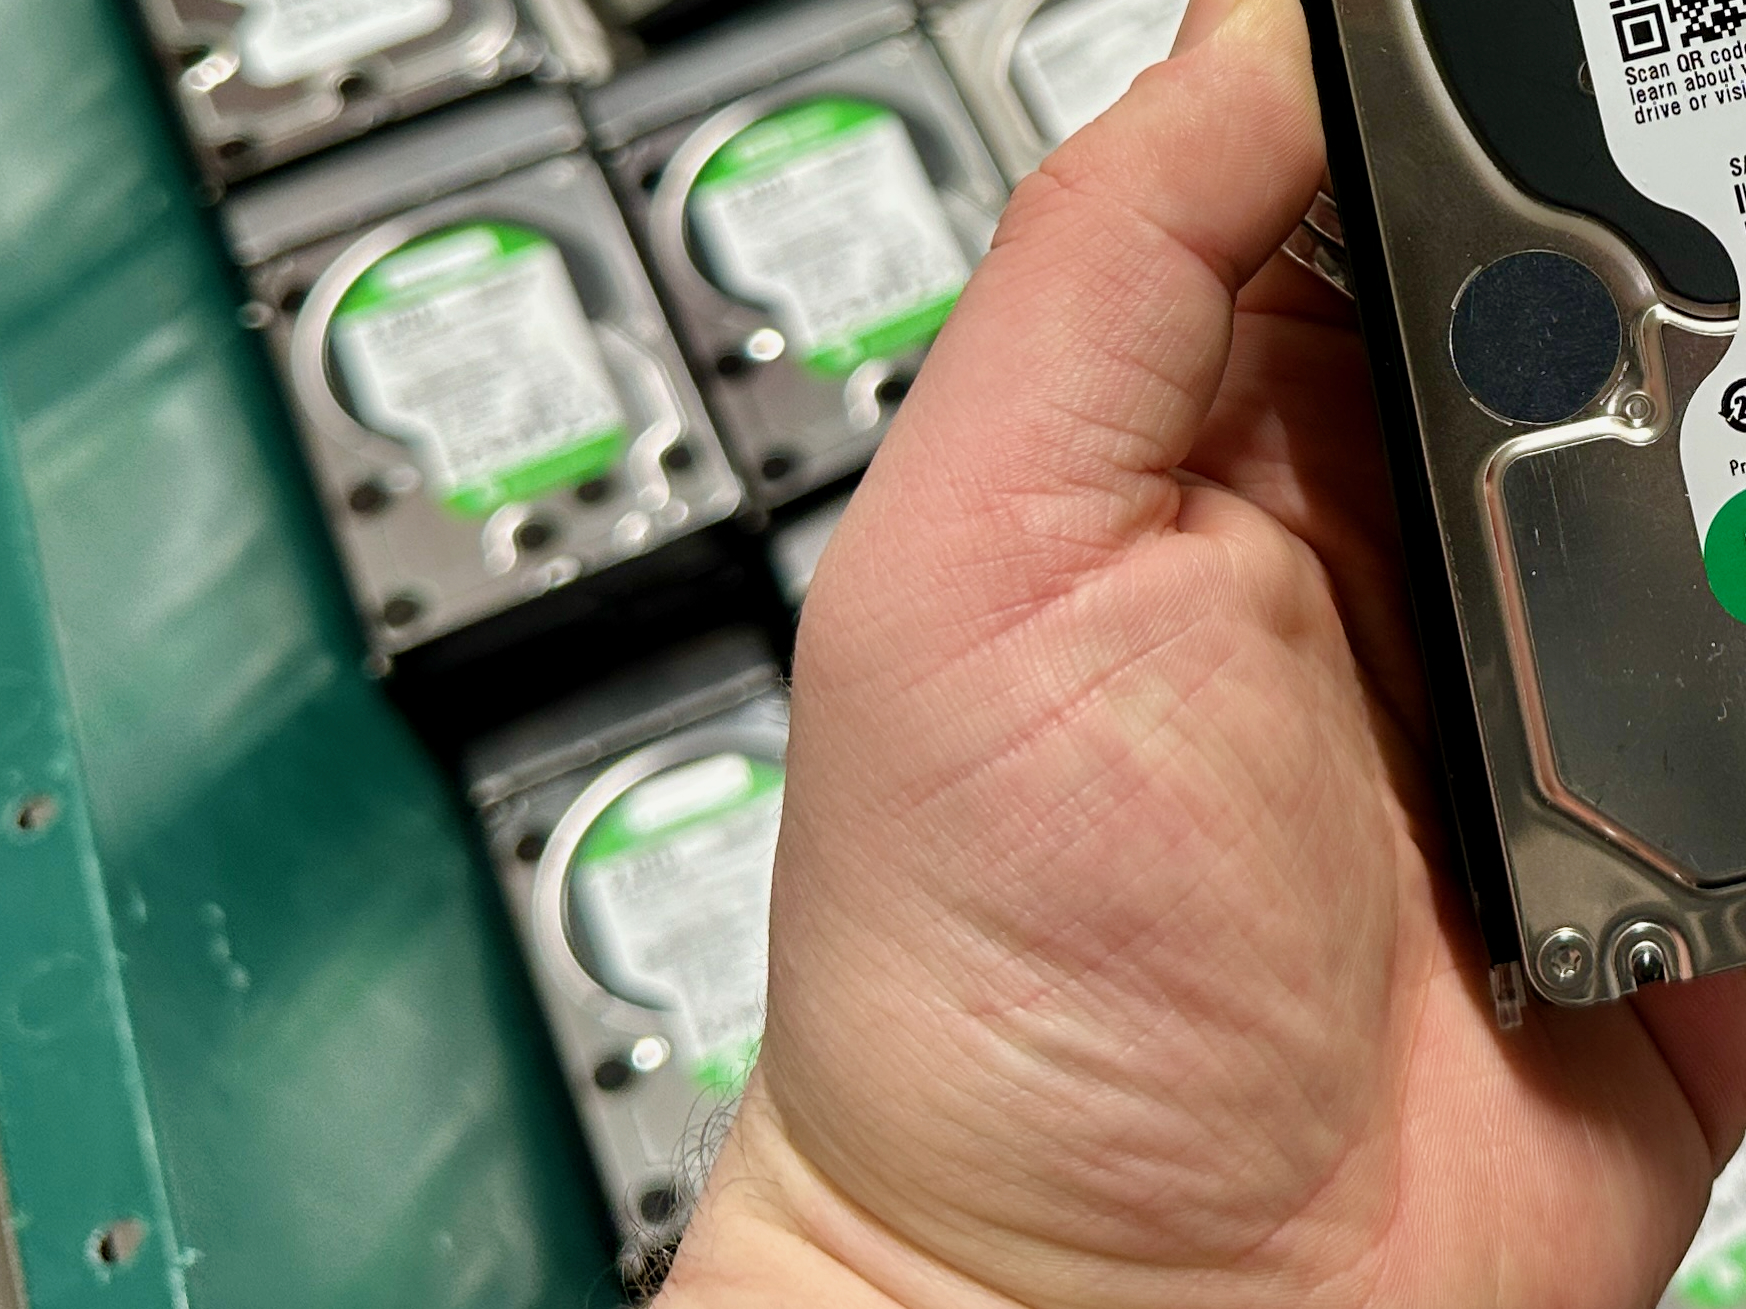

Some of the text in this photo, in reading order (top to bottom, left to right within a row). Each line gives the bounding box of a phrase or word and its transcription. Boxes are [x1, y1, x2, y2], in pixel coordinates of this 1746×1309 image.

[1624, 62, 1671, 86] Scan
[1676, 49, 1706, 73] QR
[1629, 81, 1678, 106] learn
[1684, 63, 1737, 92] about
[1634, 100, 1682, 125] drive
[1688, 93, 1707, 112] or
